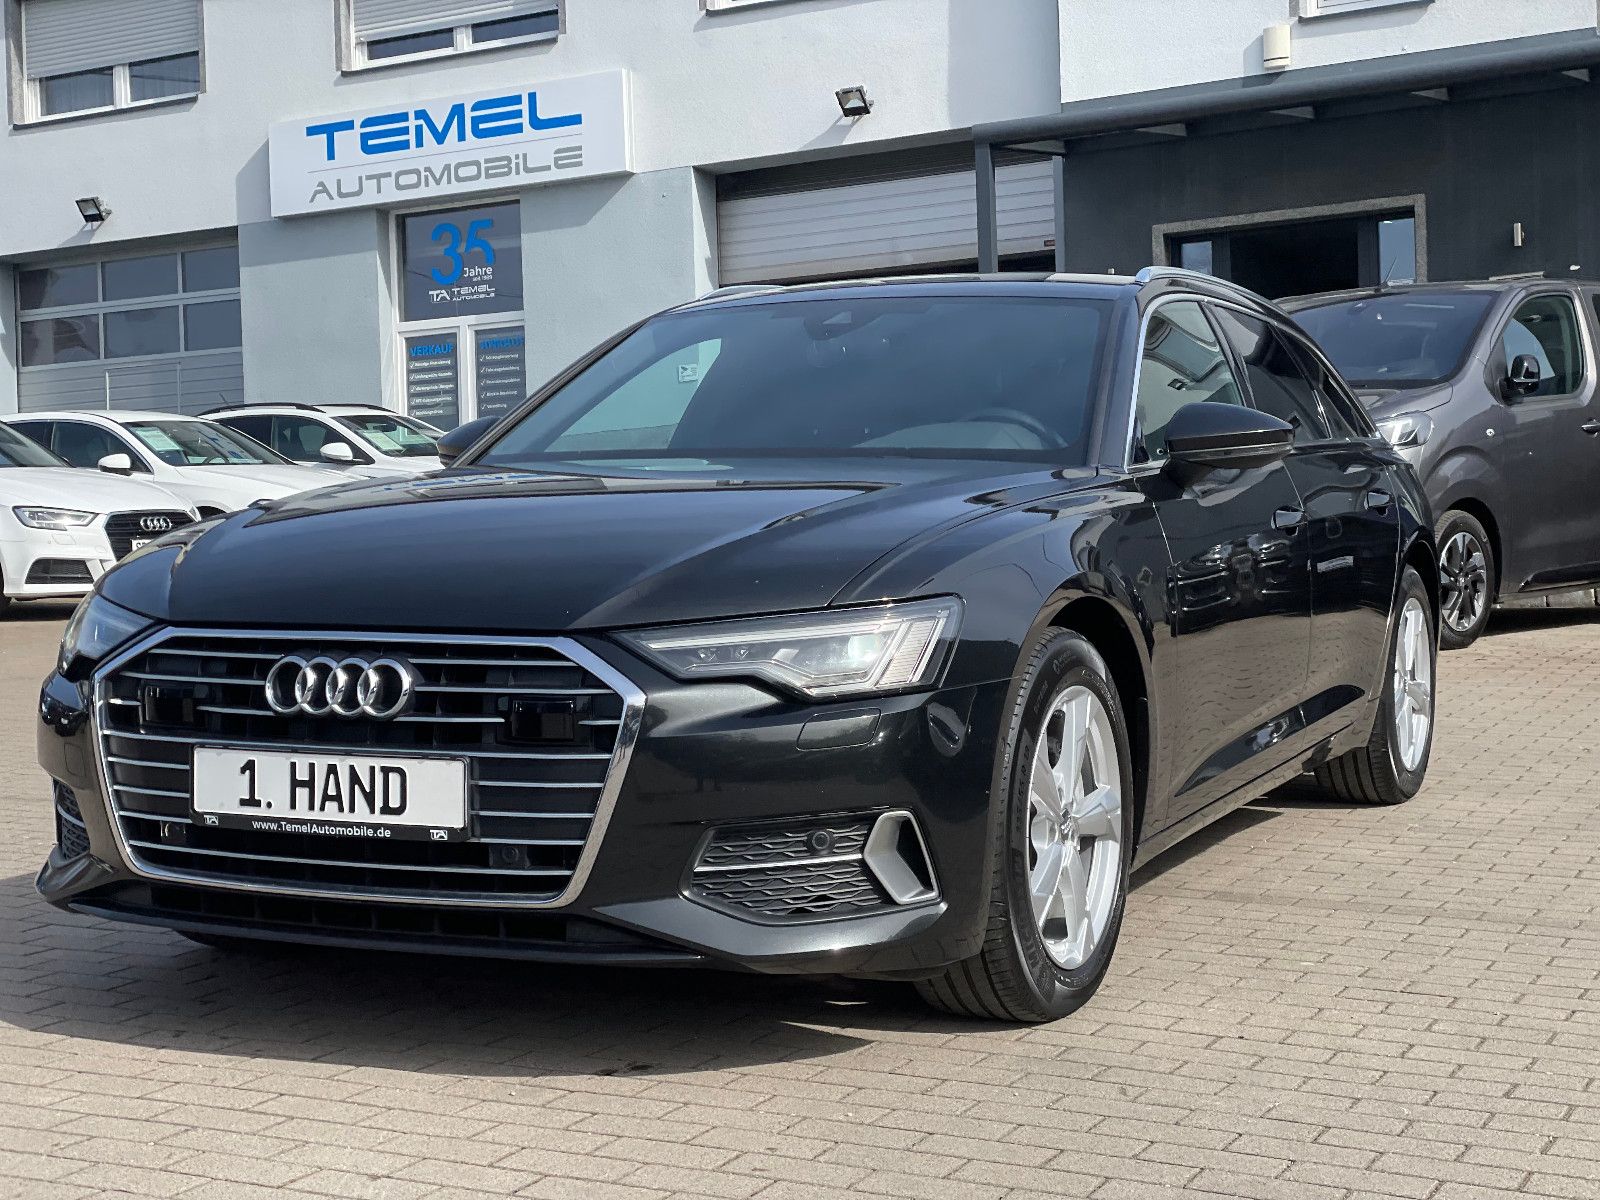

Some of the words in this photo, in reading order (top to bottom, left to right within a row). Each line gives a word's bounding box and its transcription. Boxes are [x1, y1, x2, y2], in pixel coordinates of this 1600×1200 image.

[305, 91, 583, 161] TEMEL
[431, 218, 495, 286] 35
[463, 266, 493, 278] Jahre
[451, 284, 496, 295] TEMEL
[410, 342, 454, 357] VERKAUF
[239, 758, 273, 809] 1.
[290, 760, 408, 816] HAND
[252, 820, 392, 838] www.TemelAutomobile.de
